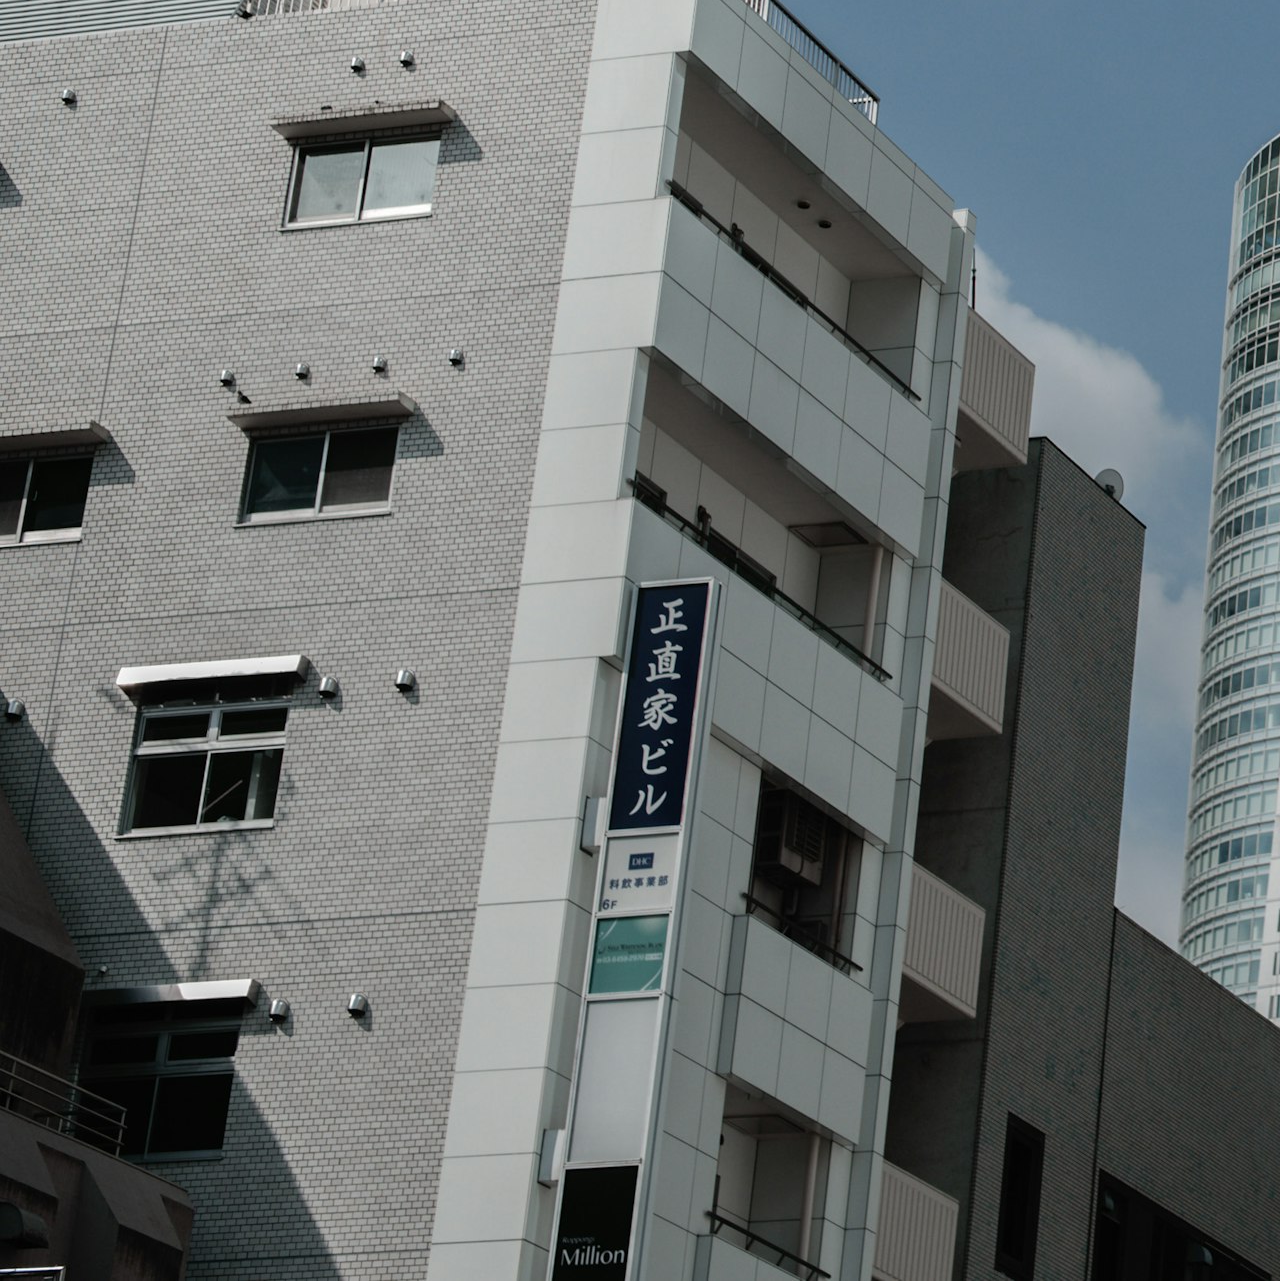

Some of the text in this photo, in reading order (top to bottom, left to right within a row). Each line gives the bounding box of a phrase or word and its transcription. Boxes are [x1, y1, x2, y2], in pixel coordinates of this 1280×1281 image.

[629, 598, 689, 816] 正直家ビル
[631, 856, 651, 866] DHC
[609, 875, 668, 889] 料飲事業部
[602, 898, 617, 910] 6F
[561, 1245, 625, 1266] Million
